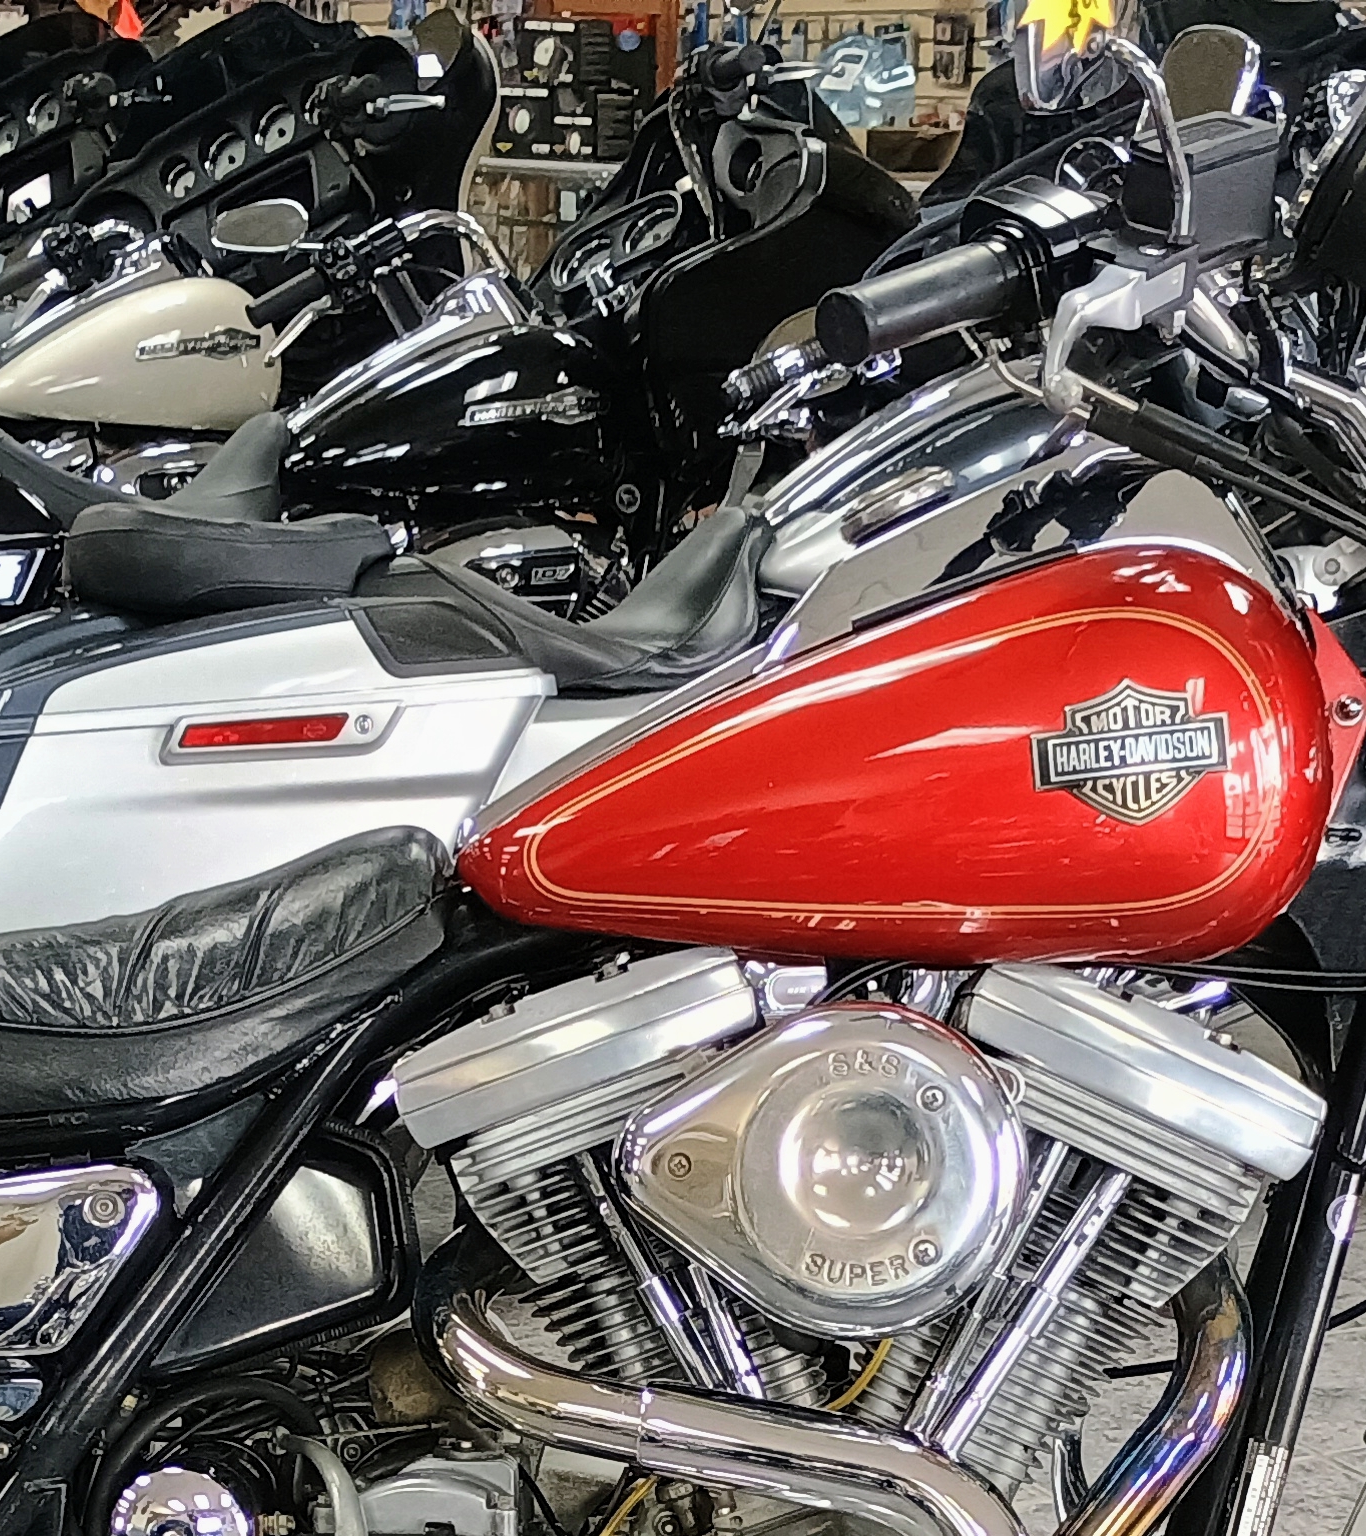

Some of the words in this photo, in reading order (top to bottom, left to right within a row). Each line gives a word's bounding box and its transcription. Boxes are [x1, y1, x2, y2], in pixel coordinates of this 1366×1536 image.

[1091, 699, 1173, 733] MOTOR
[1055, 729, 1211, 773] HARLEY-DAVIDSON
[1096, 771, 1178, 810] CYCLES
[828, 1048, 901, 1079] S&S
[805, 1253, 910, 1287] SUPER
